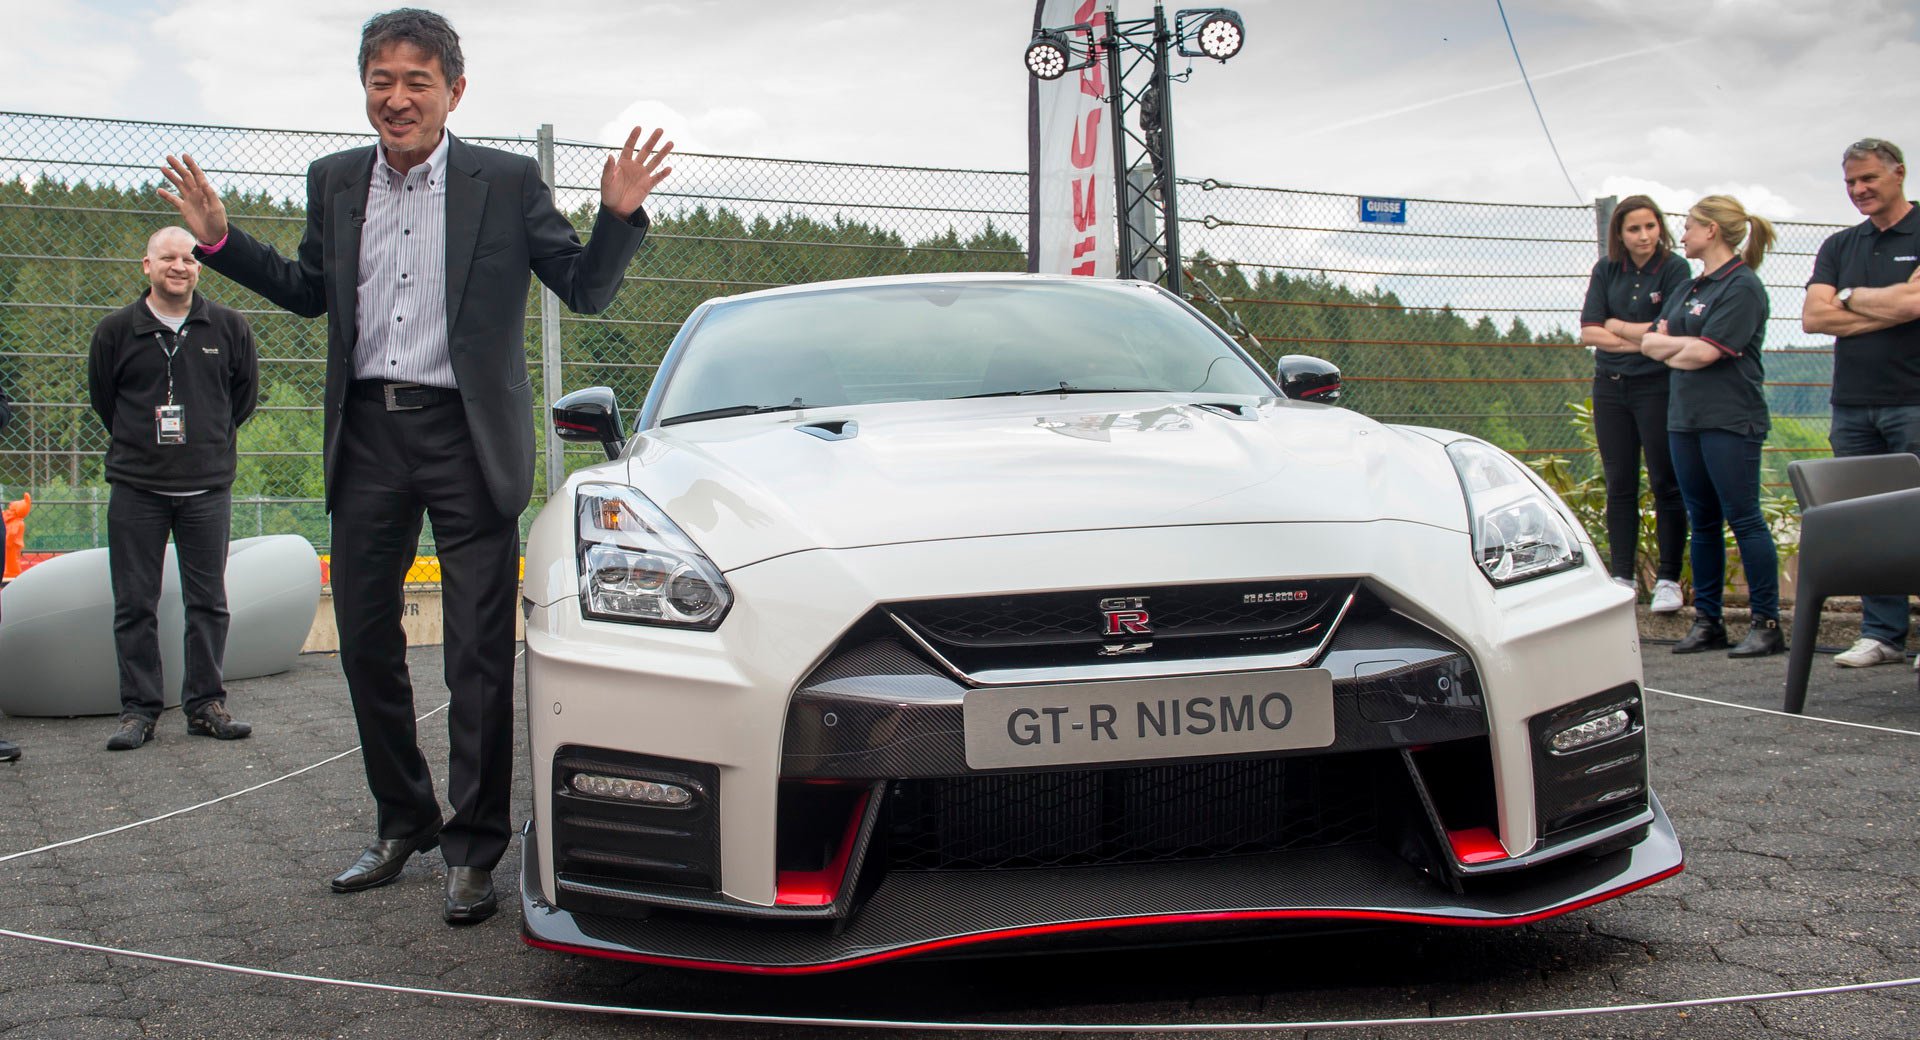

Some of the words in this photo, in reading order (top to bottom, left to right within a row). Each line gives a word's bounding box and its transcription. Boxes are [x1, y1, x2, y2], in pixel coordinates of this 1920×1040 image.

[1366, 200, 1401, 213] GUISSE
[1100, 596, 1151, 610] GT
[1102, 610, 1153, 635] R
[1007, 703, 1118, 746] GT-R
[1136, 692, 1293, 738] NISMO
